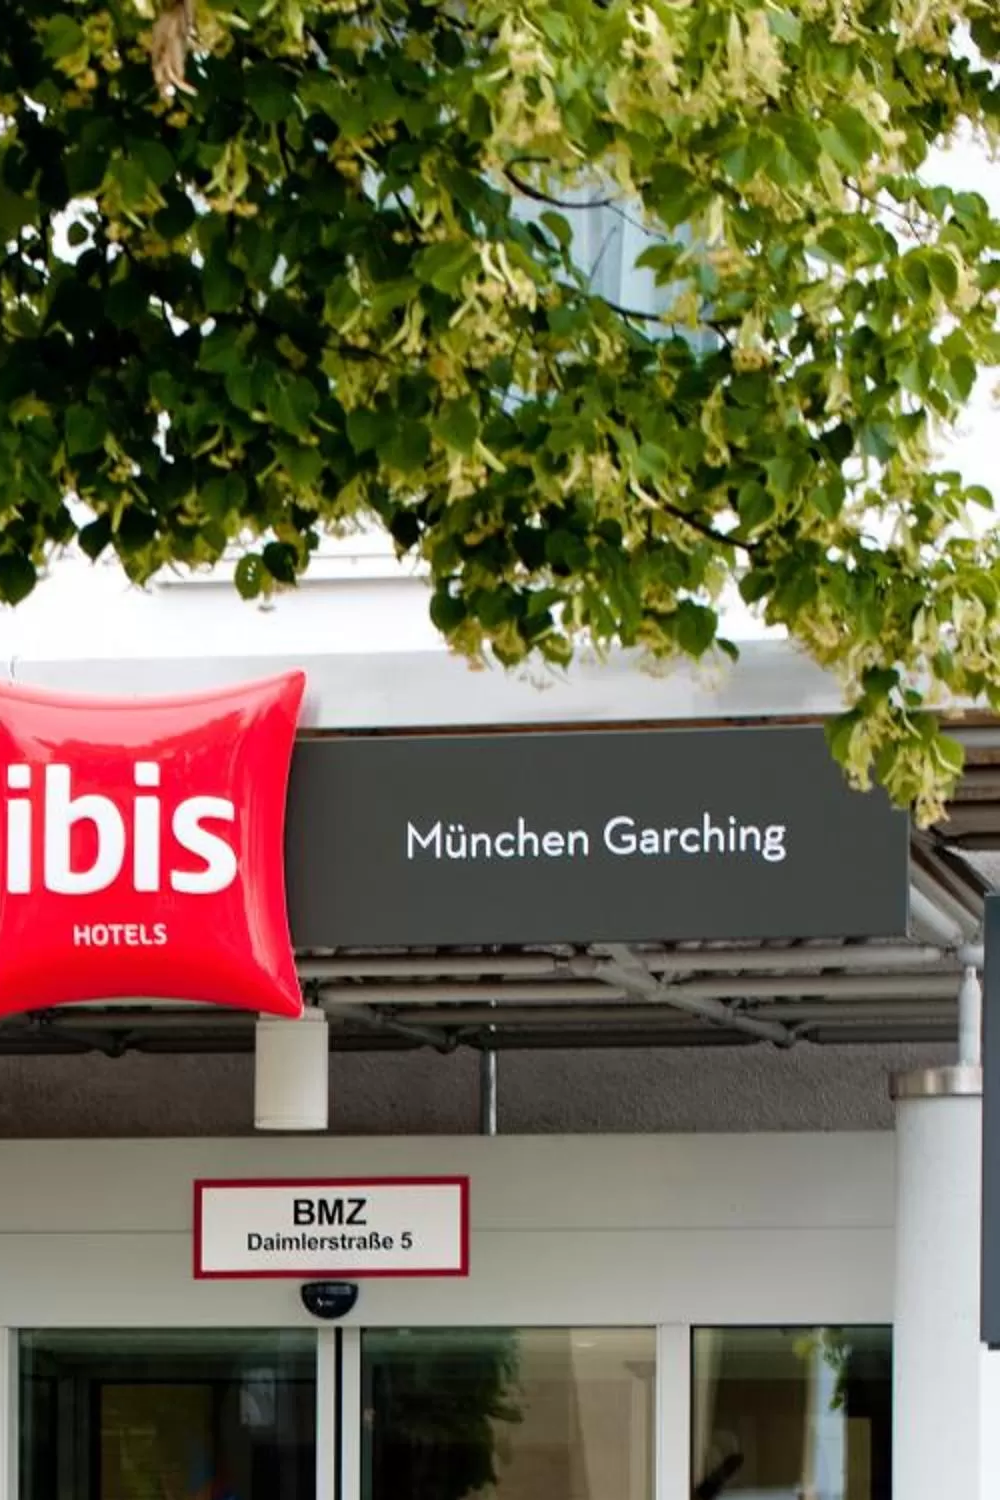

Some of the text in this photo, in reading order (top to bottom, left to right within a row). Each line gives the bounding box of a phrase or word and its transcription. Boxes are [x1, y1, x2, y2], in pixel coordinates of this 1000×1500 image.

[6, 761, 238, 895] ibis
[406, 811, 787, 862] München Garching
[72, 922, 168, 946] HOTELS
[293, 1198, 367, 1226] BMZ
[247, 1231, 413, 1252] Daimlerstraße 5
